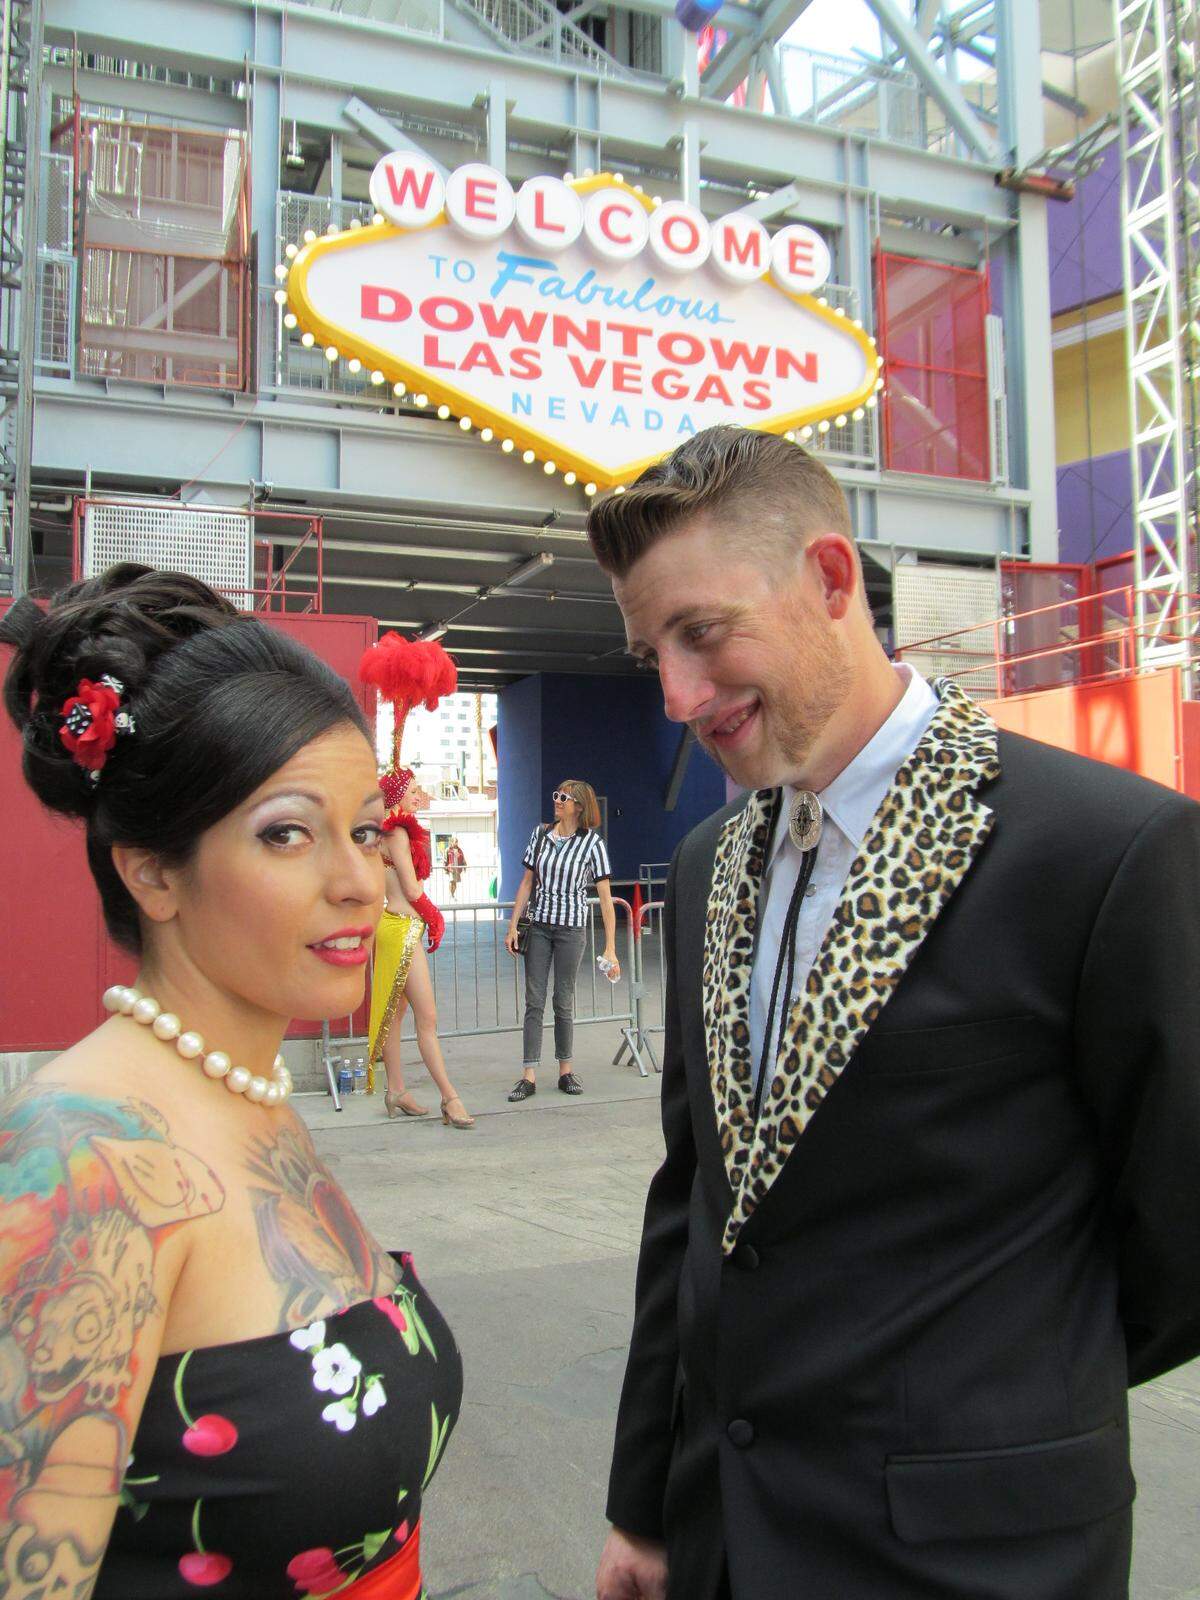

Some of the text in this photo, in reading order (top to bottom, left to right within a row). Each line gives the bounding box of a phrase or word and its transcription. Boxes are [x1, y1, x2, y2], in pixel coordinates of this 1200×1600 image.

[385, 164, 815, 277] WELCOME
[428, 251, 734, 324] TO Fabulous
[361, 284, 818, 384] DOWNTOWN
[423, 334, 773, 410] LAS VEGAS
[511, 391, 697, 434] NEVADA
